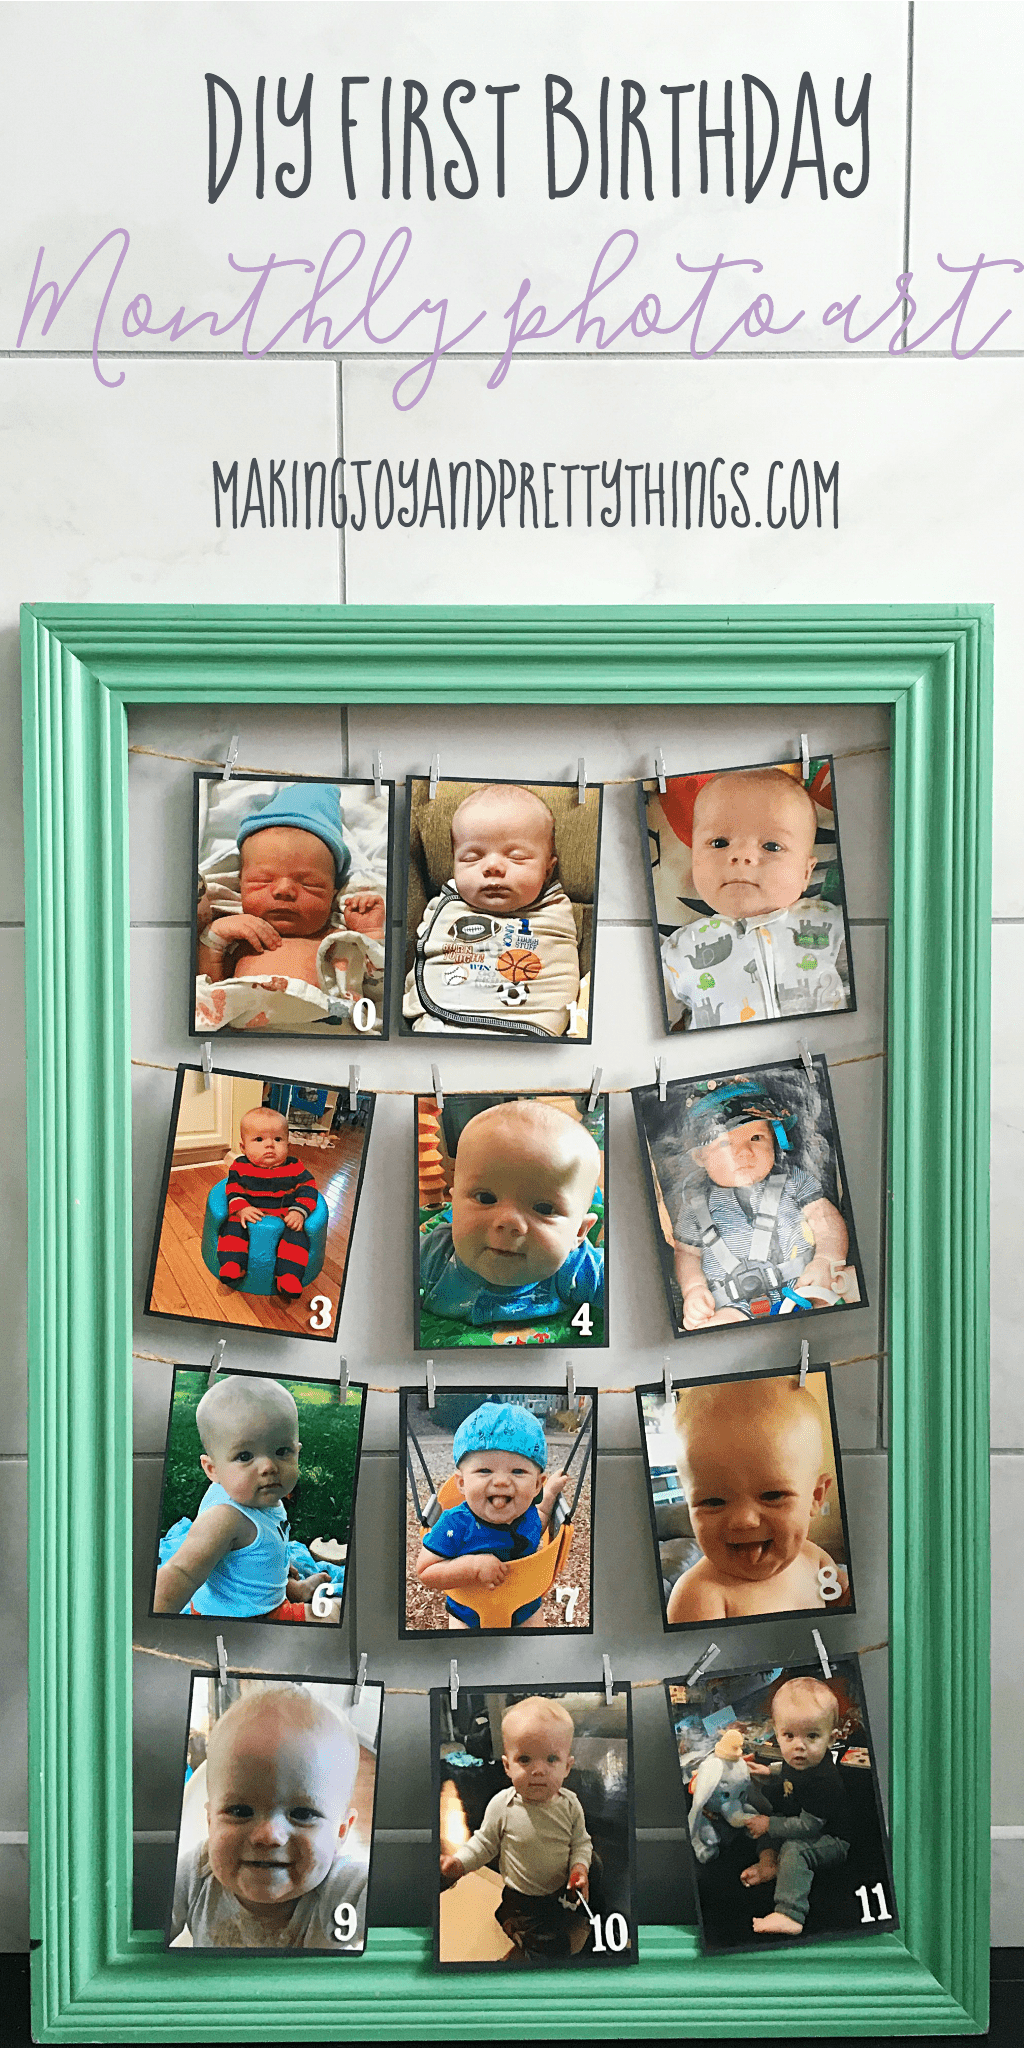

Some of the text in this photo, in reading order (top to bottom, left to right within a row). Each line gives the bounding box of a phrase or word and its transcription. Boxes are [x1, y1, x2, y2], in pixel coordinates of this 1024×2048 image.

[819, 970, 841, 1003] 2
[352, 997, 377, 1032] 0
[566, 1000, 580, 1035] 1
[830, 1260, 850, 1294] 5
[309, 1294, 333, 1330] 3
[571, 1302, 594, 1336] 4
[311, 1582, 335, 1618] 6
[817, 1565, 842, 1601] 8
[555, 1586, 580, 1623] 7
[855, 1882, 892, 1923] 11
[333, 1902, 358, 1941] 9
[589, 1912, 629, 1953] 10
